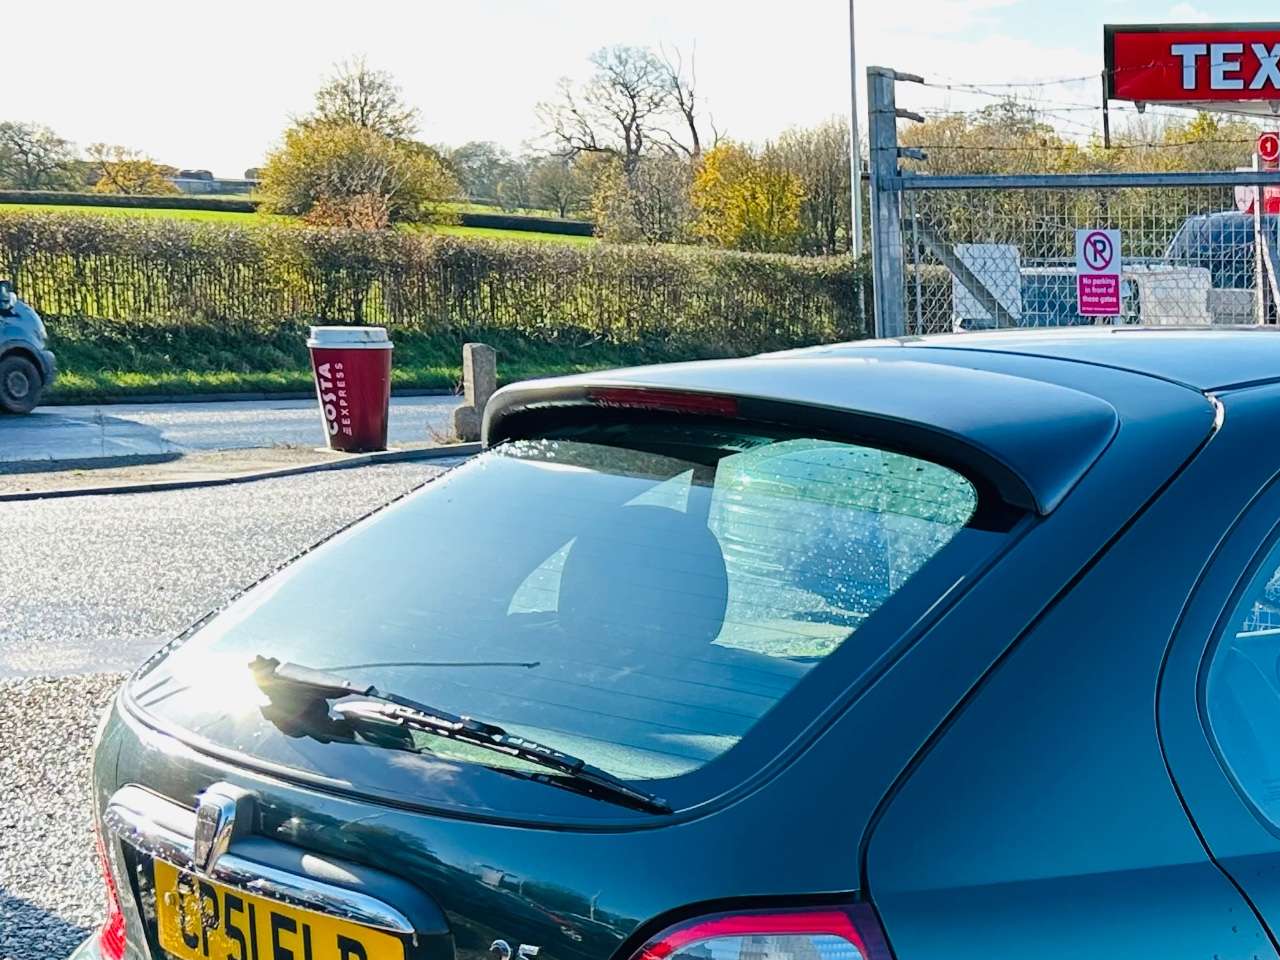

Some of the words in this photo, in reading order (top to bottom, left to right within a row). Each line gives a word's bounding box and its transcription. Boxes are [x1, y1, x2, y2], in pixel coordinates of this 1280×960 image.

[1265, 141, 1272, 153] 1
[1082, 277, 1092, 285] No
[1093, 278, 1116, 286] parking
[318, 362, 339, 436] COSTA
[335, 362, 351, 425] EXPRESS
